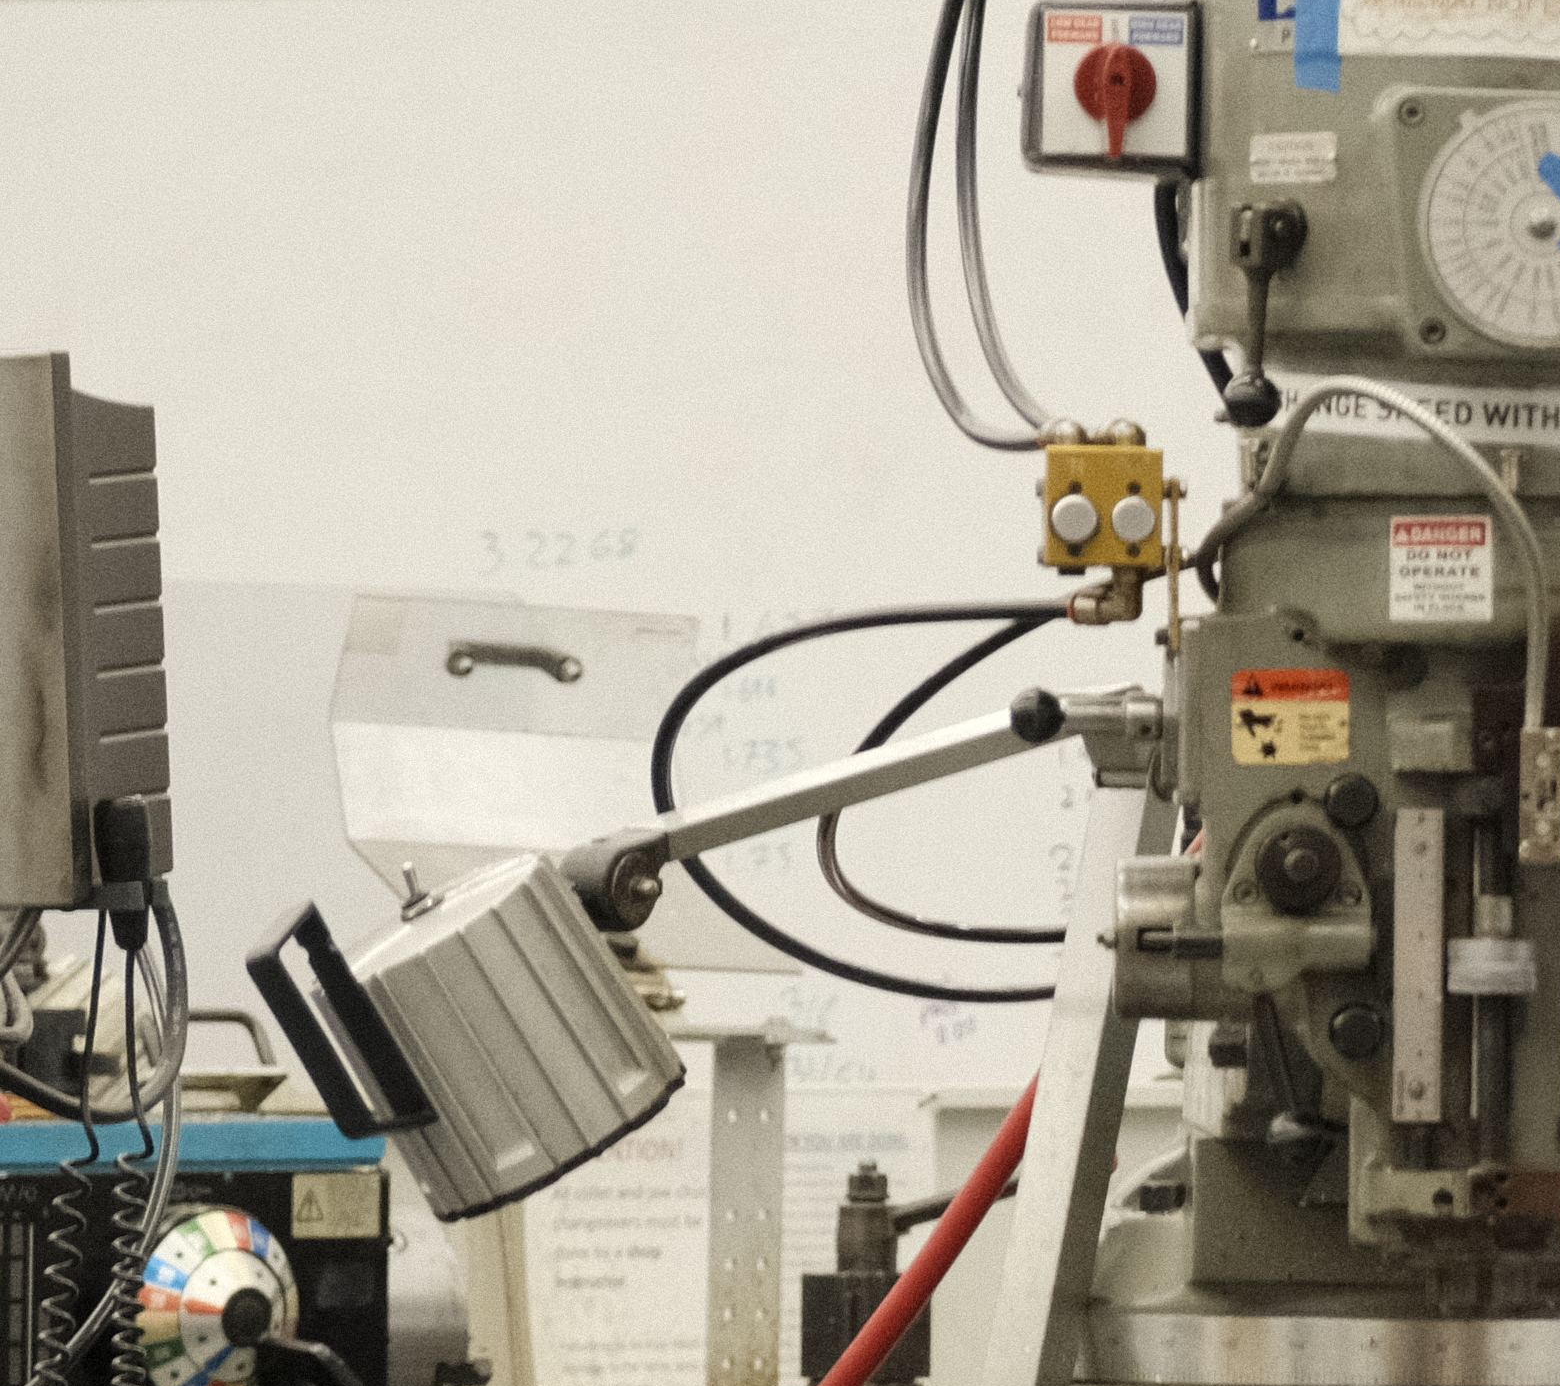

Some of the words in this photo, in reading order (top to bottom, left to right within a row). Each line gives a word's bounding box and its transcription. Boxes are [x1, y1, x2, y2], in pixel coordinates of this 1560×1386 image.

[1481, 402, 1560, 430] WITH
[1410, 524, 1483, 544] DANGER
[1405, 550, 1431, 562] DO
[1436, 550, 1473, 562] NOT
[1398, 565, 1481, 579] OPERATE
